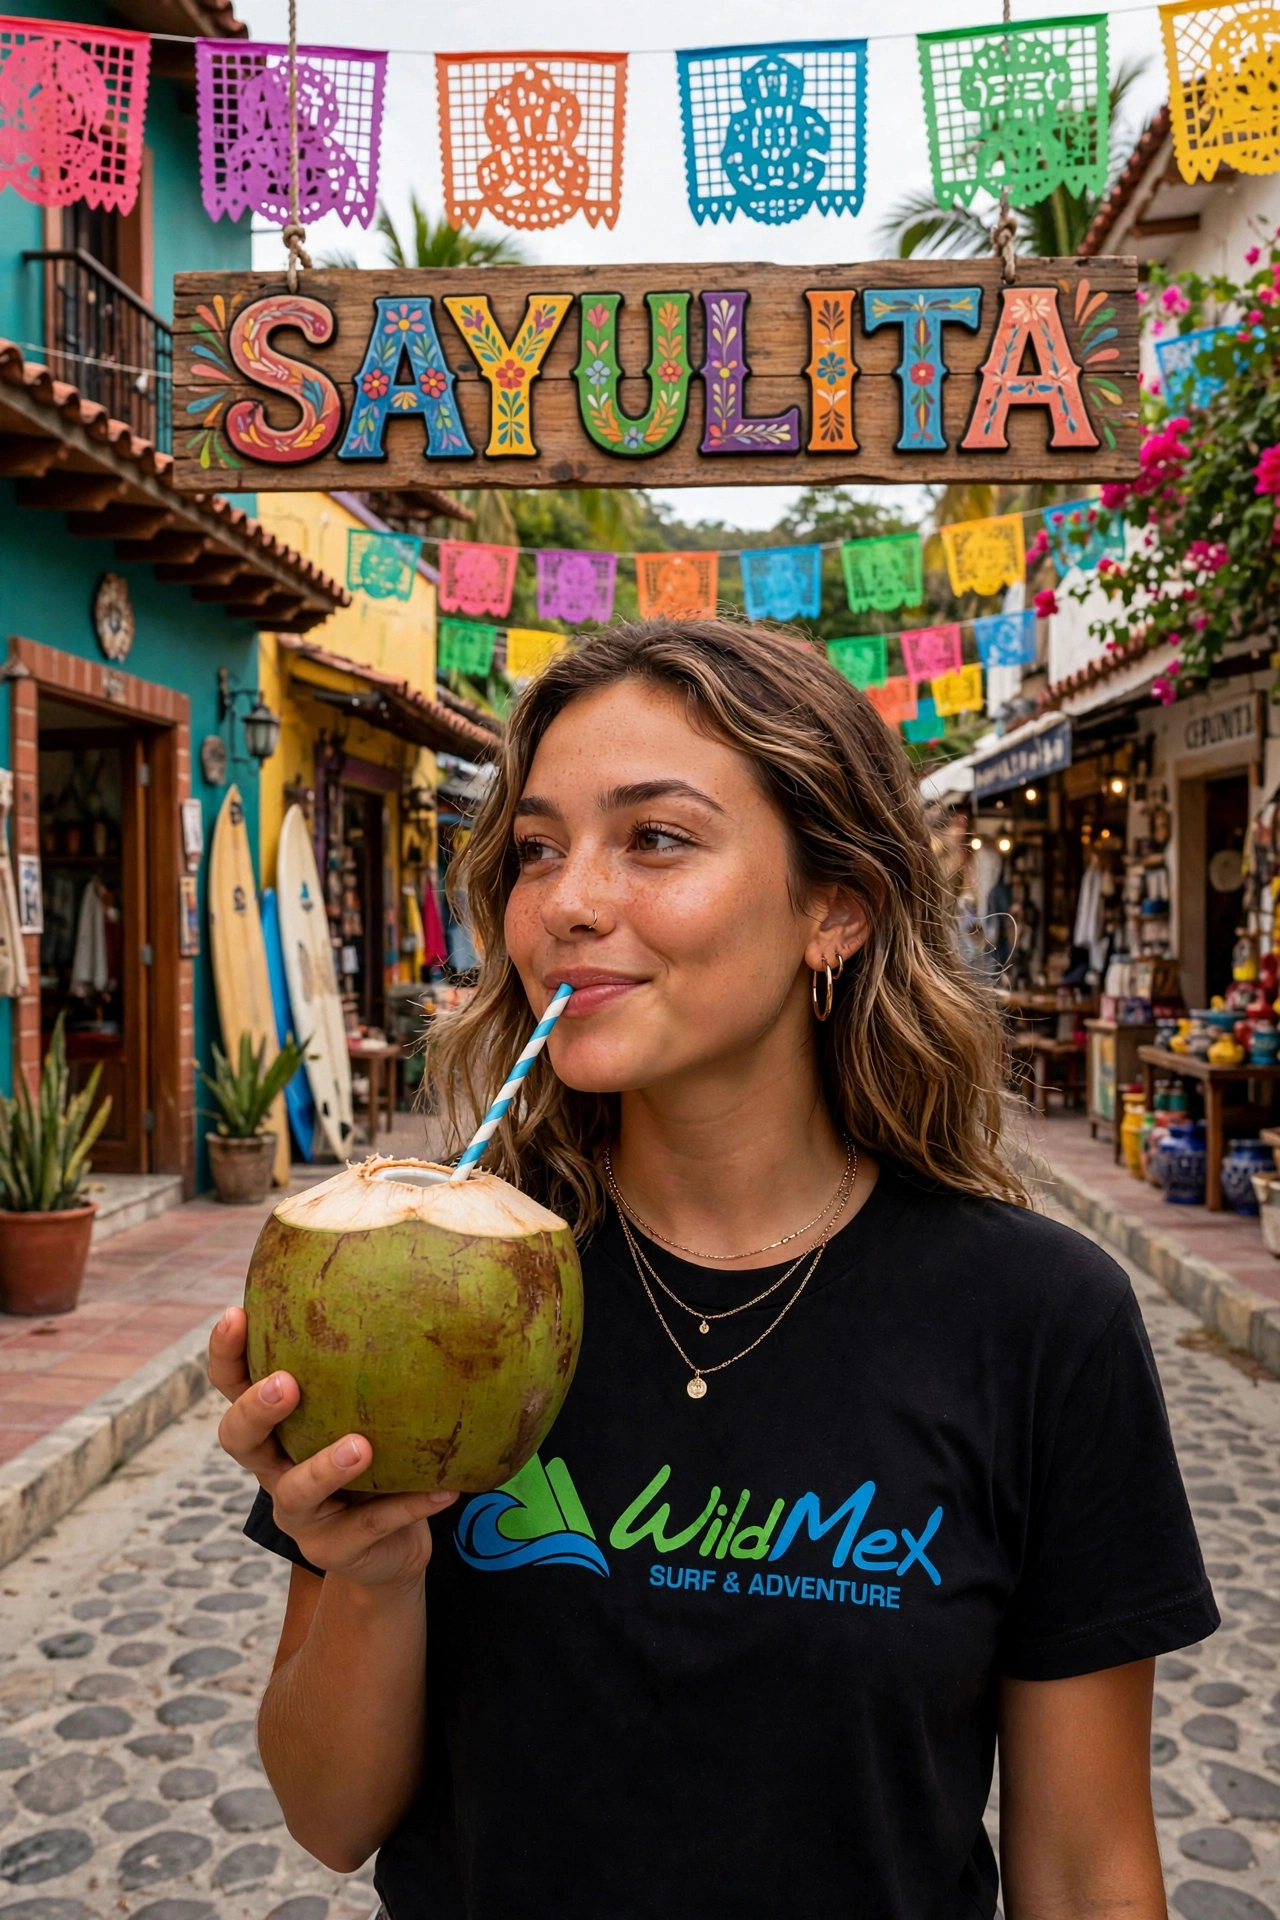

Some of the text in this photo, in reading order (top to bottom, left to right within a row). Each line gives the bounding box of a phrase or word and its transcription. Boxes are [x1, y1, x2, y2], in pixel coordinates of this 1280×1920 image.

[224, 284, 1102, 465] SAYULITA
[649, 1564, 901, 1609] SURF & ADVENTURE
